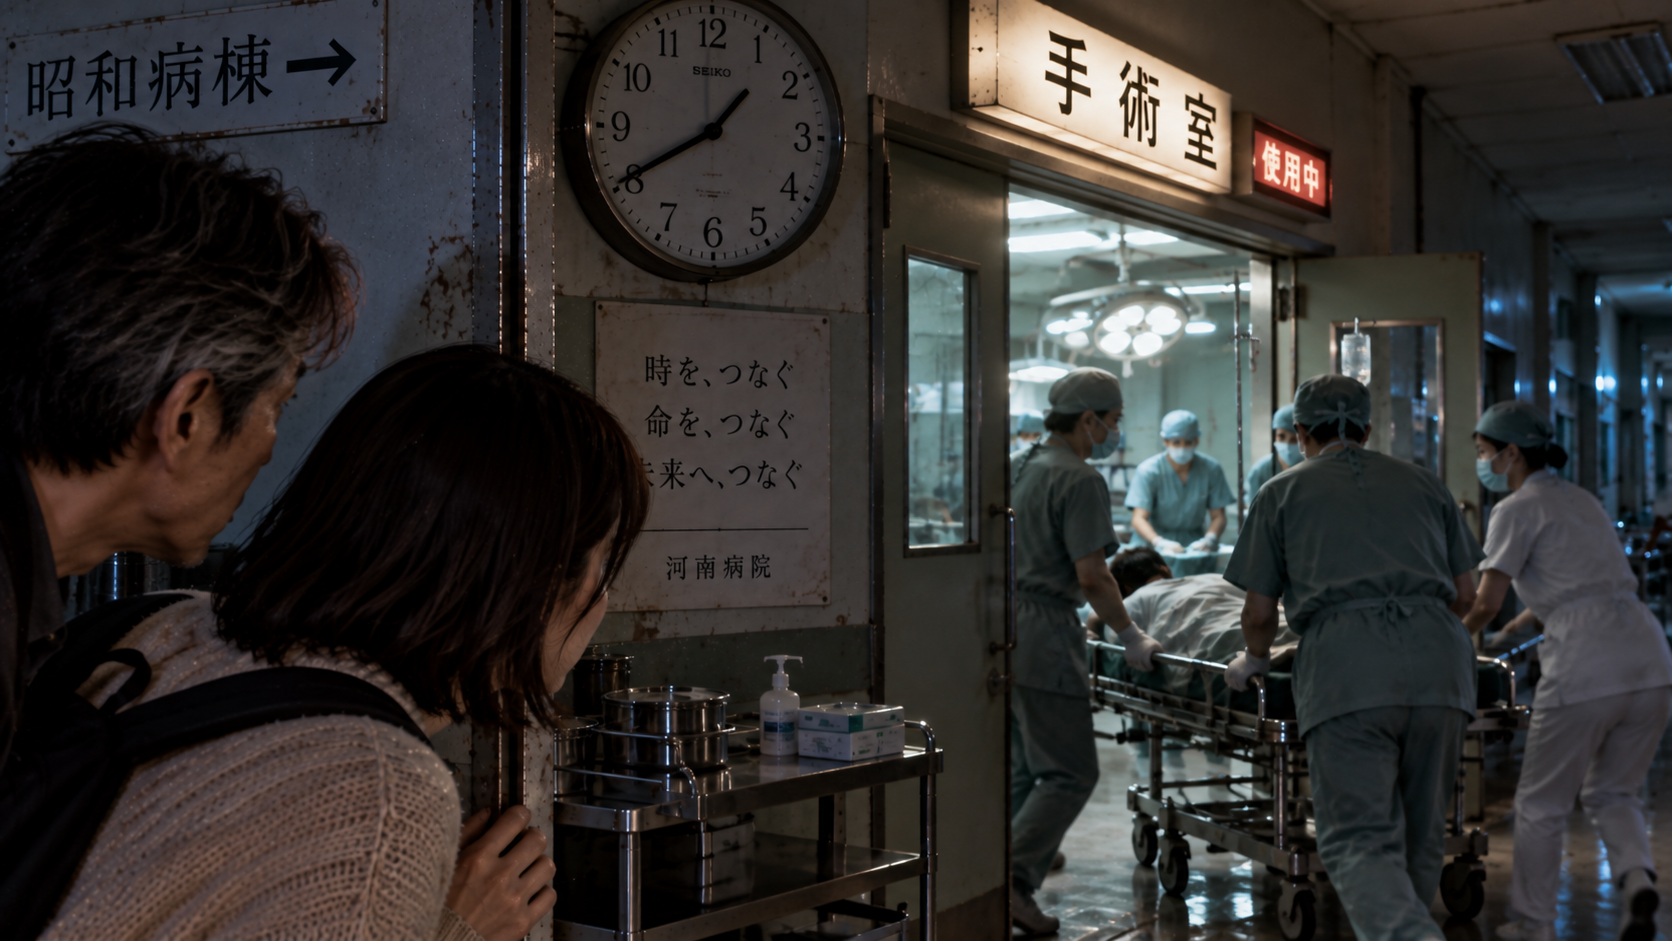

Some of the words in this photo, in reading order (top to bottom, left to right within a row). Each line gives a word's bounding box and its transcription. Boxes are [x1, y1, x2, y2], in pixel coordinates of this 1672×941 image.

[658, 28, 679, 58] 11
[698, 18, 727, 49] 12
[753, 34, 763, 64] 1
[27, 33, 273, 121] 昭和病棟
[623, 62, 651, 92] 10
[692, 65, 732, 78] SEIKO
[781, 70, 799, 100] 2
[1044, 29, 1218, 171] 手術室
[611, 111, 630, 141] 9
[793, 122, 812, 152] 3
[624, 164, 644, 194] 8
[1261, 140, 1320, 199] 使用中
[780, 172, 799, 201] 4
[659, 202, 678, 231] 7
[749, 206, 767, 236] 5
[703, 217, 723, 248] 6
[645, 354, 793, 390] 時を、つなぐ
[644, 404, 795, 439] 命を、つなぐ
[666, 554, 771, 580] 河南病院
